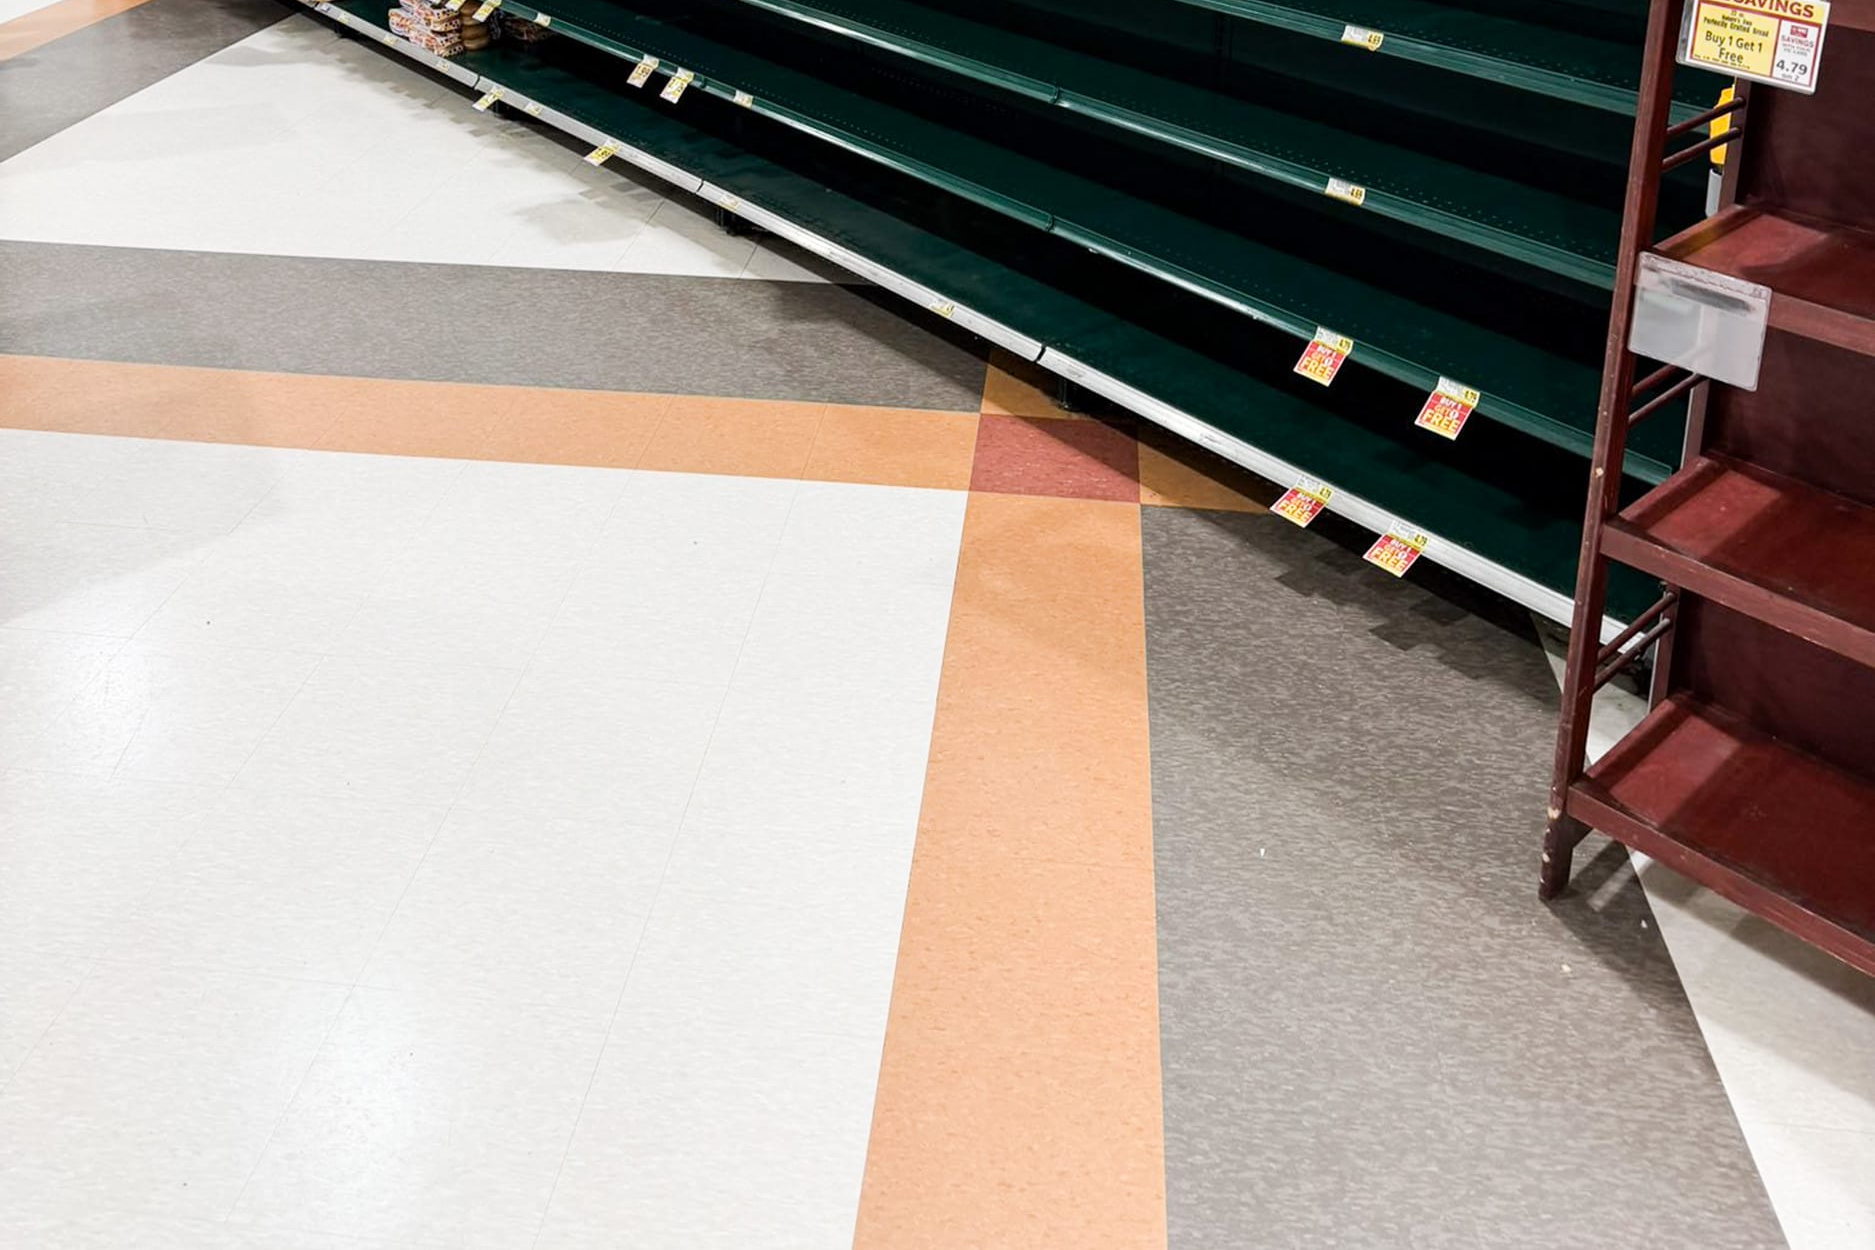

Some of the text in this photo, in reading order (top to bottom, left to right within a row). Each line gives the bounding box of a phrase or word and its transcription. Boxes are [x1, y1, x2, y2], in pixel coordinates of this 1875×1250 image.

[1705, 30, 1763, 53] Buy 1 Get 1
[1781, 35, 1814, 49] SAVINGS
[1718, 47, 1744, 64] Free
[1776, 59, 1808, 76] 4.79
[1316, 345, 1333, 357] BUY
[1301, 356, 1334, 379] FREE
[1440, 397, 1456, 409] BUY
[1423, 408, 1460, 432] FREE
[1297, 492, 1312, 503] BUY
[1279, 499, 1312, 523] FREE
[1390, 539, 1407, 550] BUY
[1370, 546, 1409, 571] FREE
